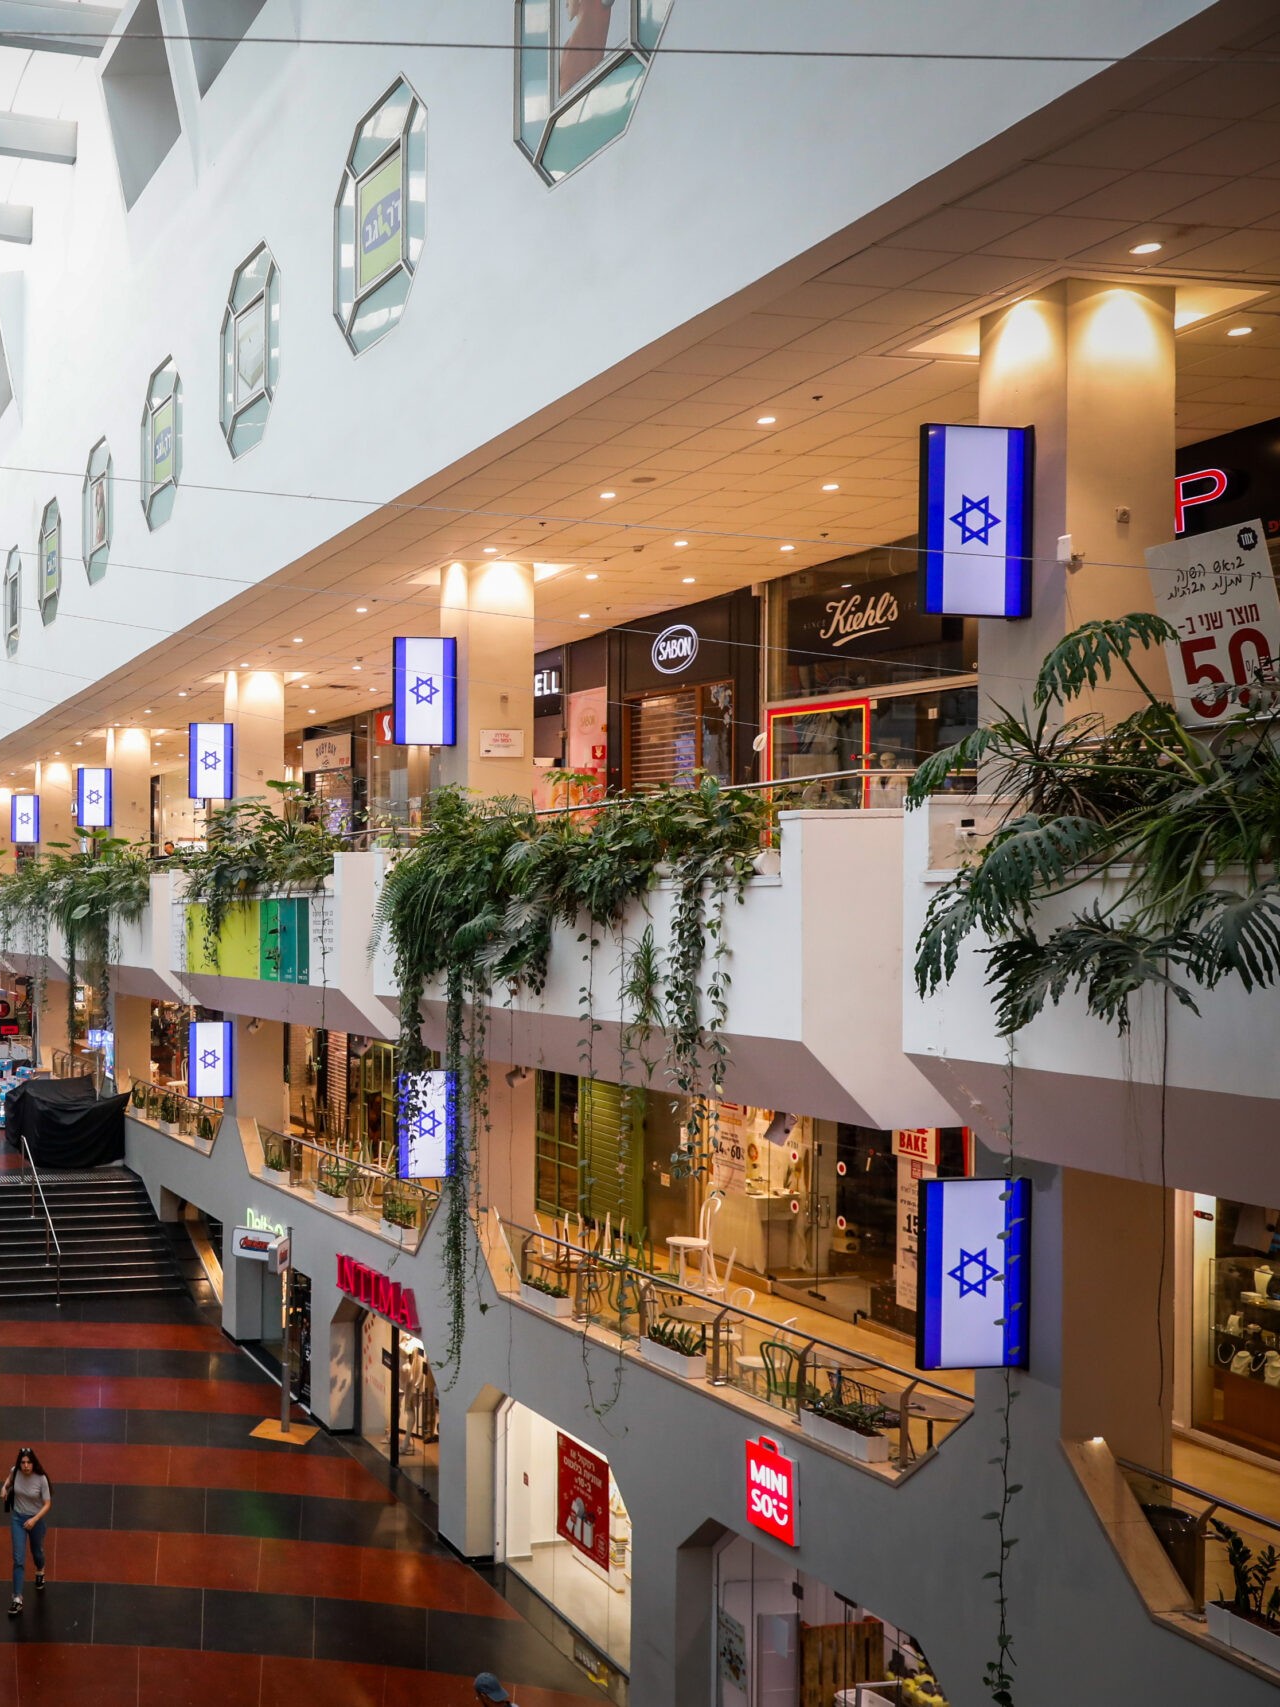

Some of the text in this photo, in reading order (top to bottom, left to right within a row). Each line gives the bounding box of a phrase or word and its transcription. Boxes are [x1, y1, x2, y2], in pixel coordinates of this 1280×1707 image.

[820, 592, 899, 639] Kiehl's
[1201, 610, 1224, 631] שני
[1226, 603, 1261, 626] מוצר
[658, 636, 692, 662] SABON
[1180, 627, 1274, 719] 50
[899, 1131, 928, 1154] BAKE
[335, 1252, 419, 1330] INTIMA
[750, 1459, 788, 1498] MINI
